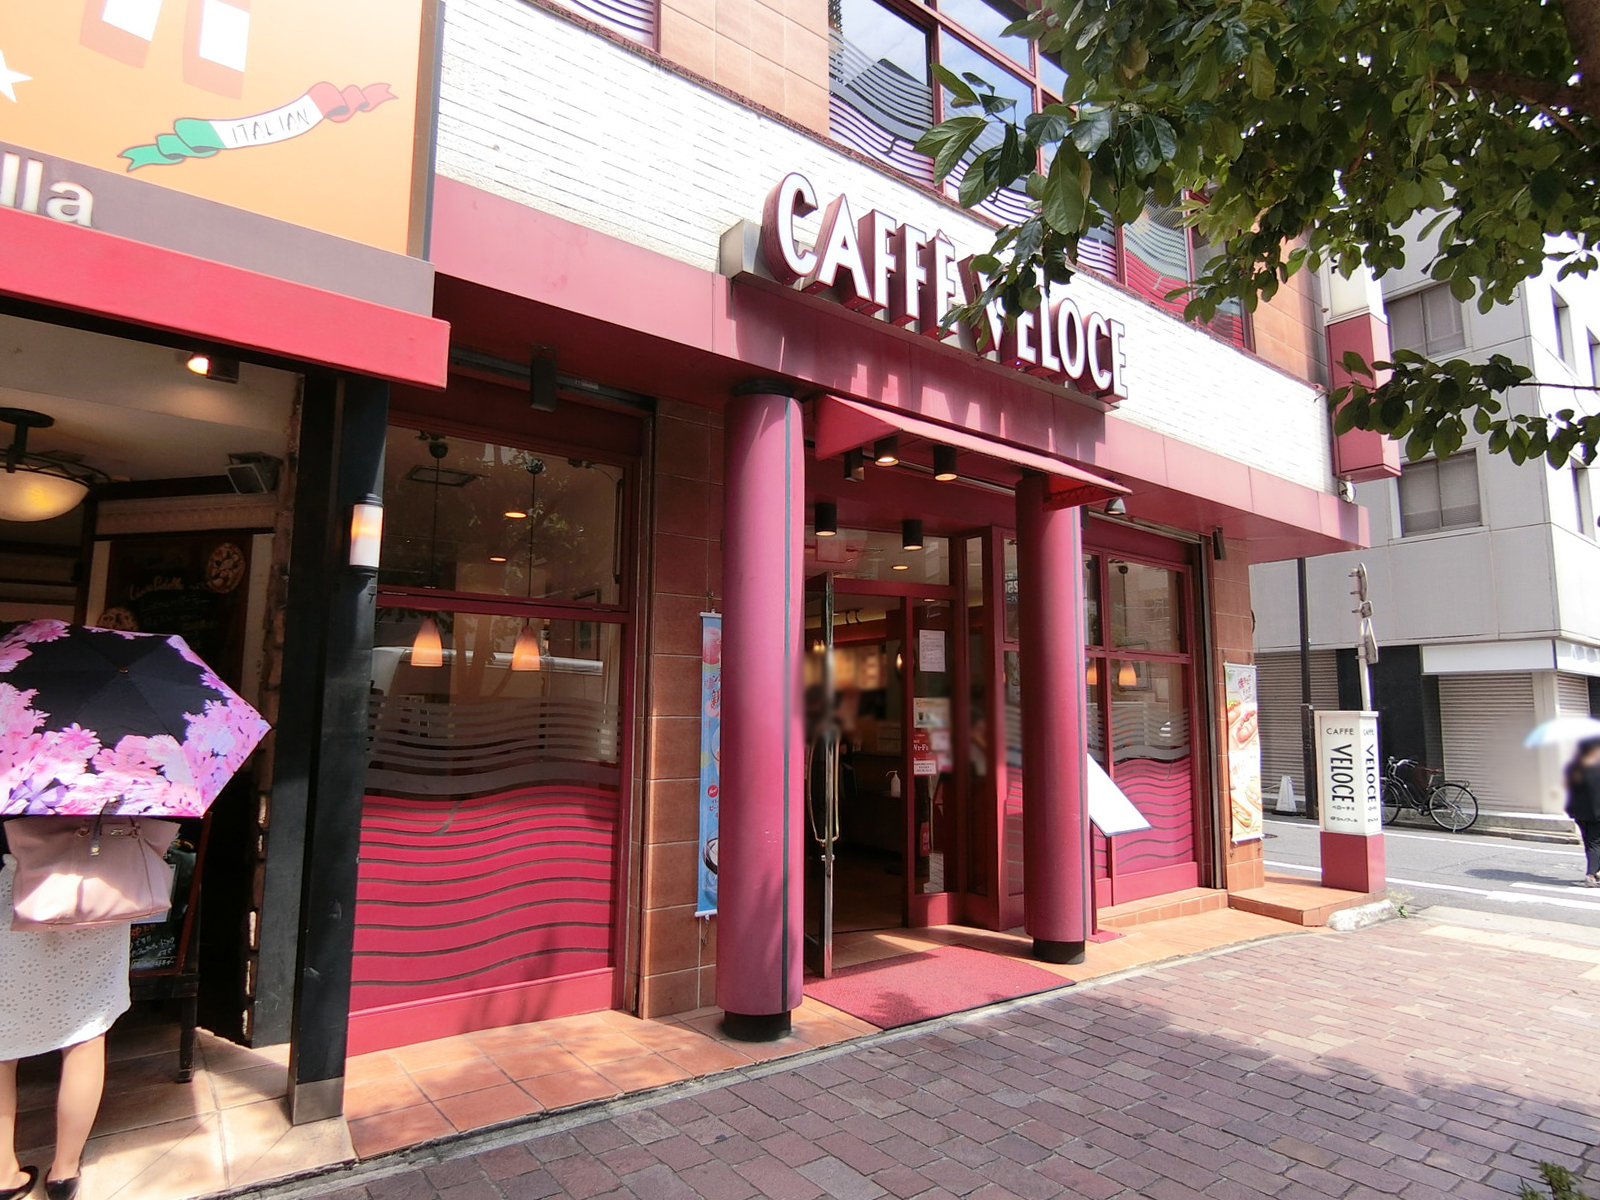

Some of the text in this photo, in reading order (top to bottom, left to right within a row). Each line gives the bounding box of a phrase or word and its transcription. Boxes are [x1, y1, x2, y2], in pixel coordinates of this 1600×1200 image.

[232, 108, 310, 145] ITALIAN
[1326, 727, 1354, 735] CAFFE
[1331, 743, 1354, 803] VELOCE
[1365, 744, 1377, 804] VELOCE
